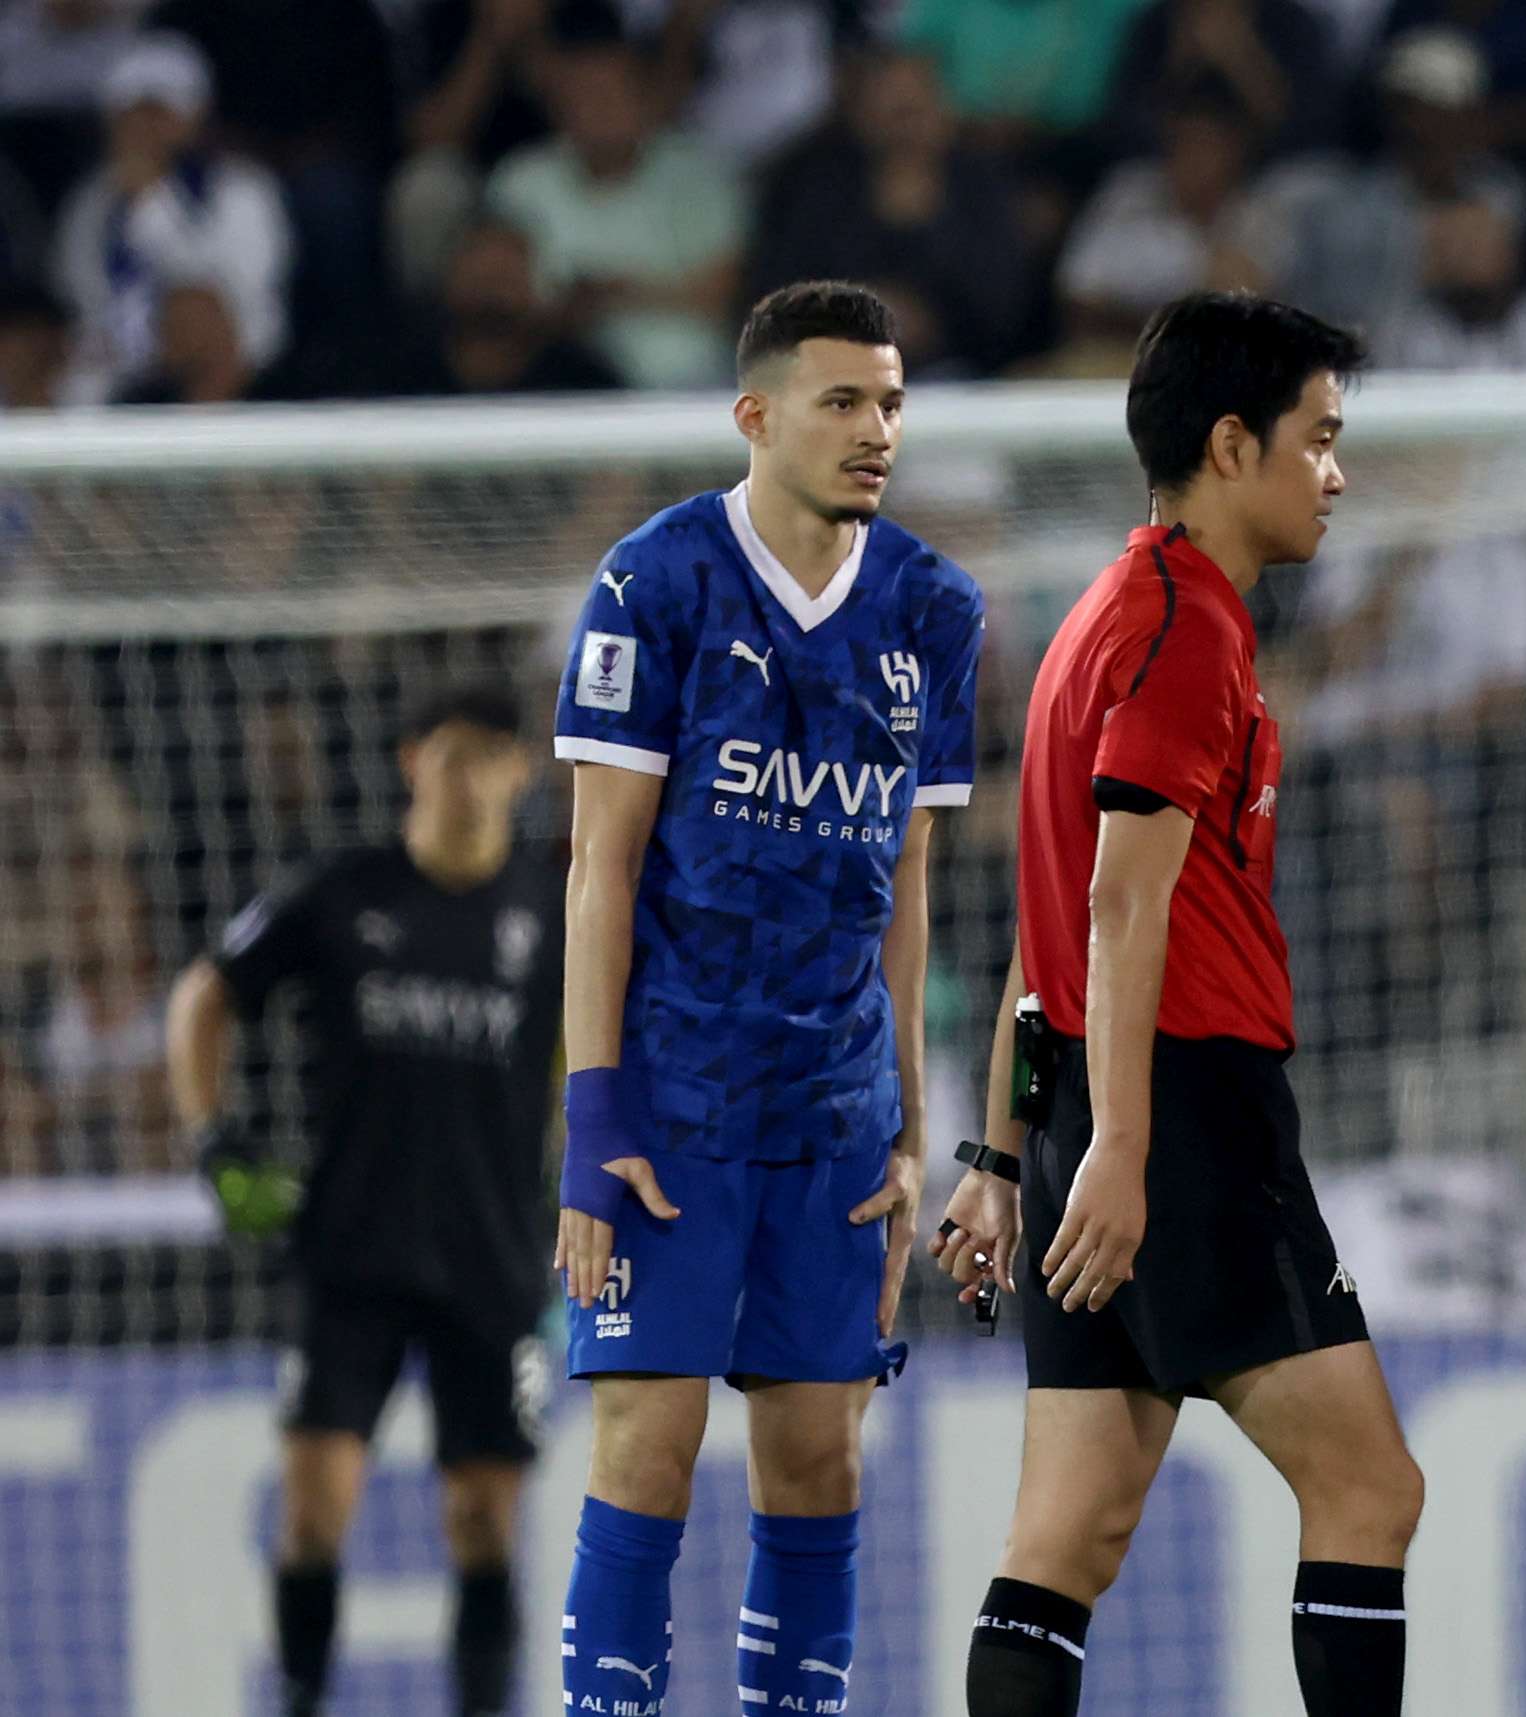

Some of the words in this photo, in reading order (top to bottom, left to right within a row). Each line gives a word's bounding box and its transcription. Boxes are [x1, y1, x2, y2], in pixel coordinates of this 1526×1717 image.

[713, 739, 906, 817] SAVVY
[713, 800, 802, 832] GAMES
[817, 821, 894, 843] GROUP
[580, 1694, 607, 1713] AL
[779, 1694, 808, 1713] AL
